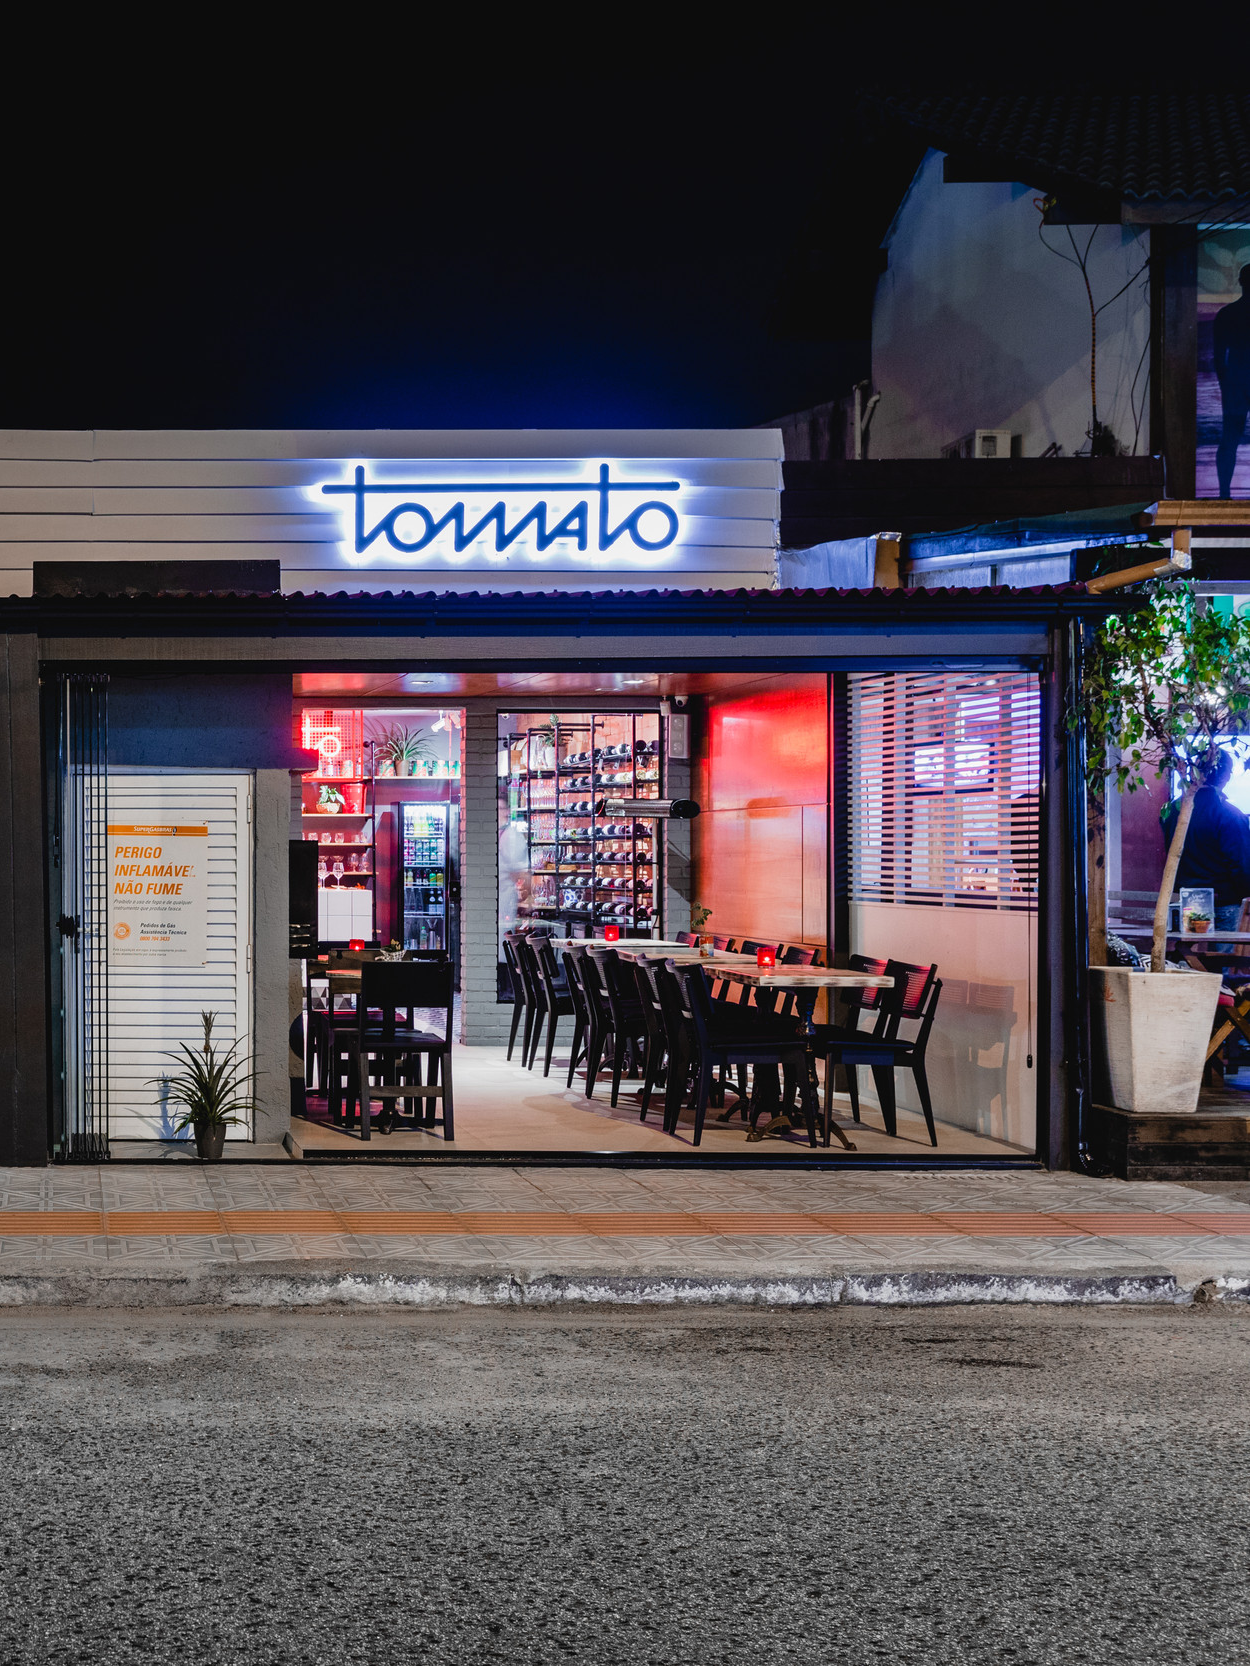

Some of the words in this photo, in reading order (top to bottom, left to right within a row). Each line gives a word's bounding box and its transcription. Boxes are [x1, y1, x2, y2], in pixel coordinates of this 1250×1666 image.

[114, 846, 163, 859] PERIGO
[114, 879, 144, 895] NÃO
[146, 883, 184, 896] FUME
